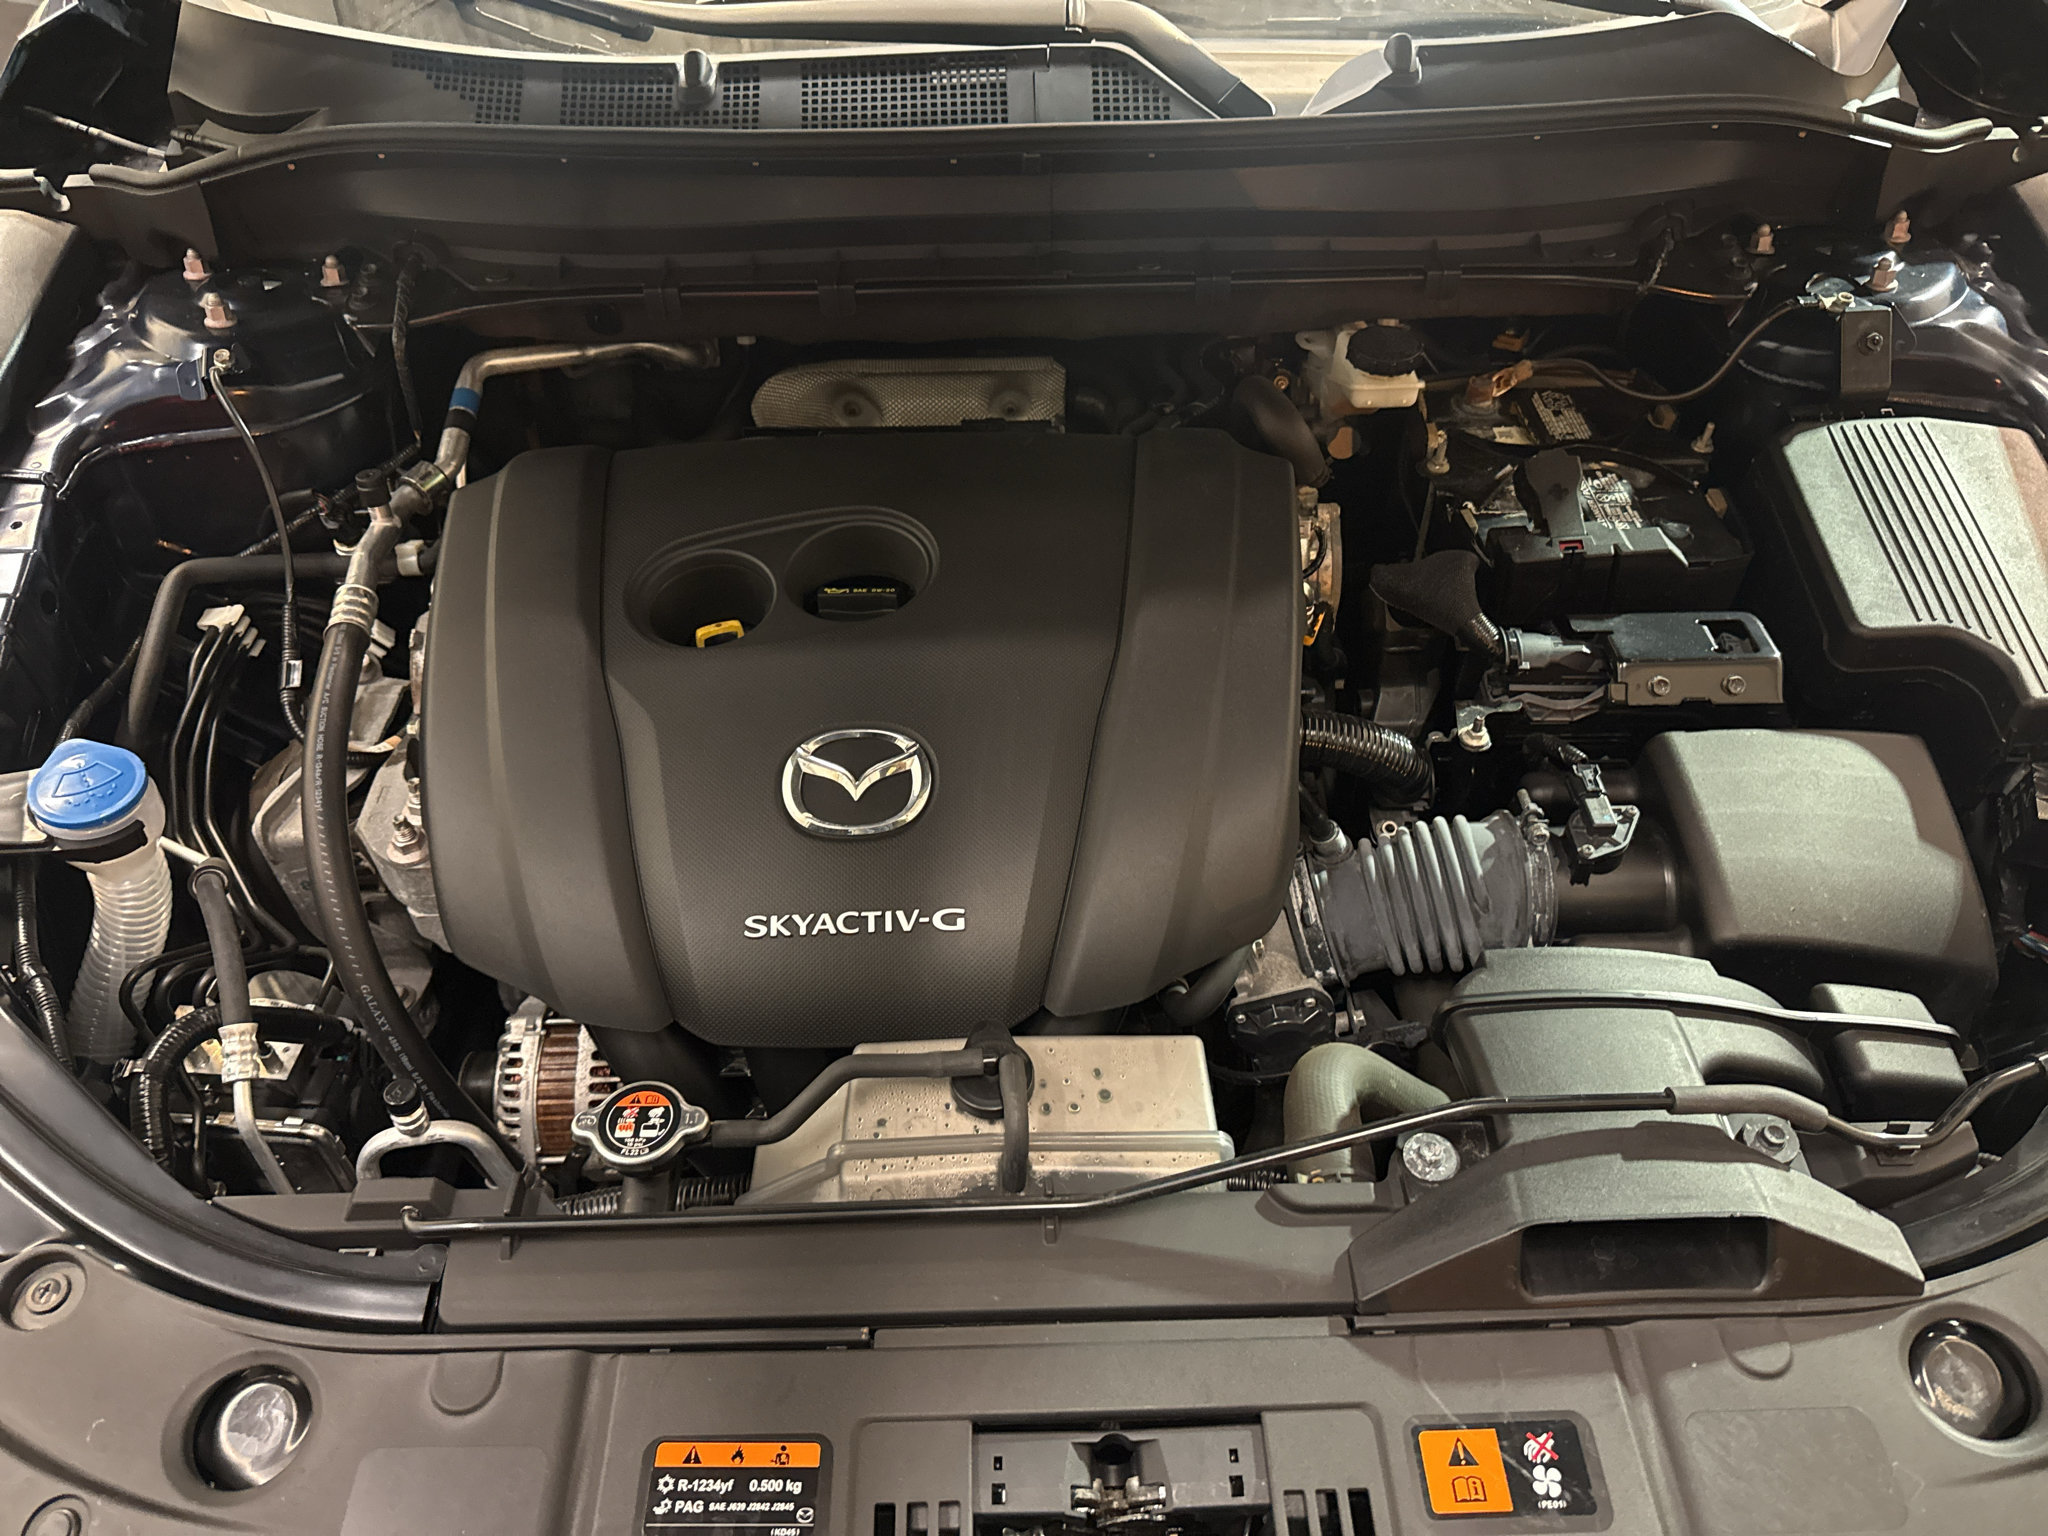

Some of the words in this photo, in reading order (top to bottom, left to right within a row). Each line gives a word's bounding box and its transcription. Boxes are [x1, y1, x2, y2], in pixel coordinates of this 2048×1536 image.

[322, 691, 331, 704] A/C
[318, 706, 329, 732] SUCTION
[316, 733, 325, 752] HOSE
[743, 908, 966, 939] SKYACTIV-G
[360, 984, 392, 1032] GALAXY
[685, 1112, 700, 1125] 1.1
[620, 1147, 640, 1156] FL22
[677, 1478, 735, 1495] R-1234yf
[749, 1478, 784, 1493] 0.500
[785, 1478, 803, 1495] kg
[674, 1499, 705, 1514] PAG
[708, 1501, 727, 1512] SAE
[727, 1501, 747, 1512] J639
[746, 1501, 771, 1512] J2842
